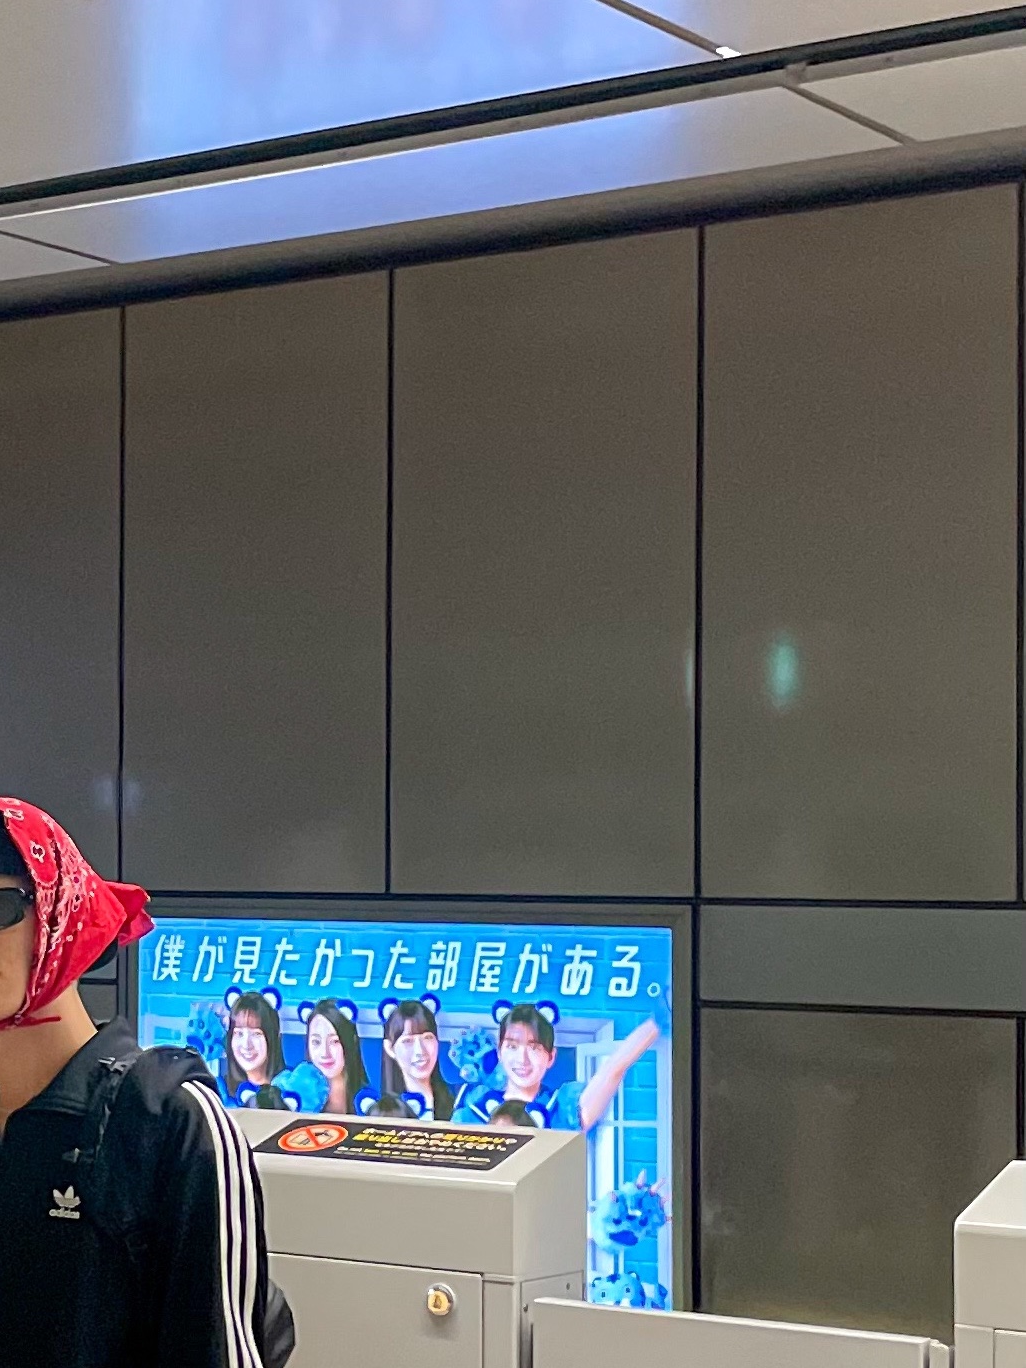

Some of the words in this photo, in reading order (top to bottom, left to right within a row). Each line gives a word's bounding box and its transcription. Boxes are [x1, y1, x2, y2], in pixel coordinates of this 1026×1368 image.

[151, 932, 662, 998] 僕が見たかった部屋がある。
